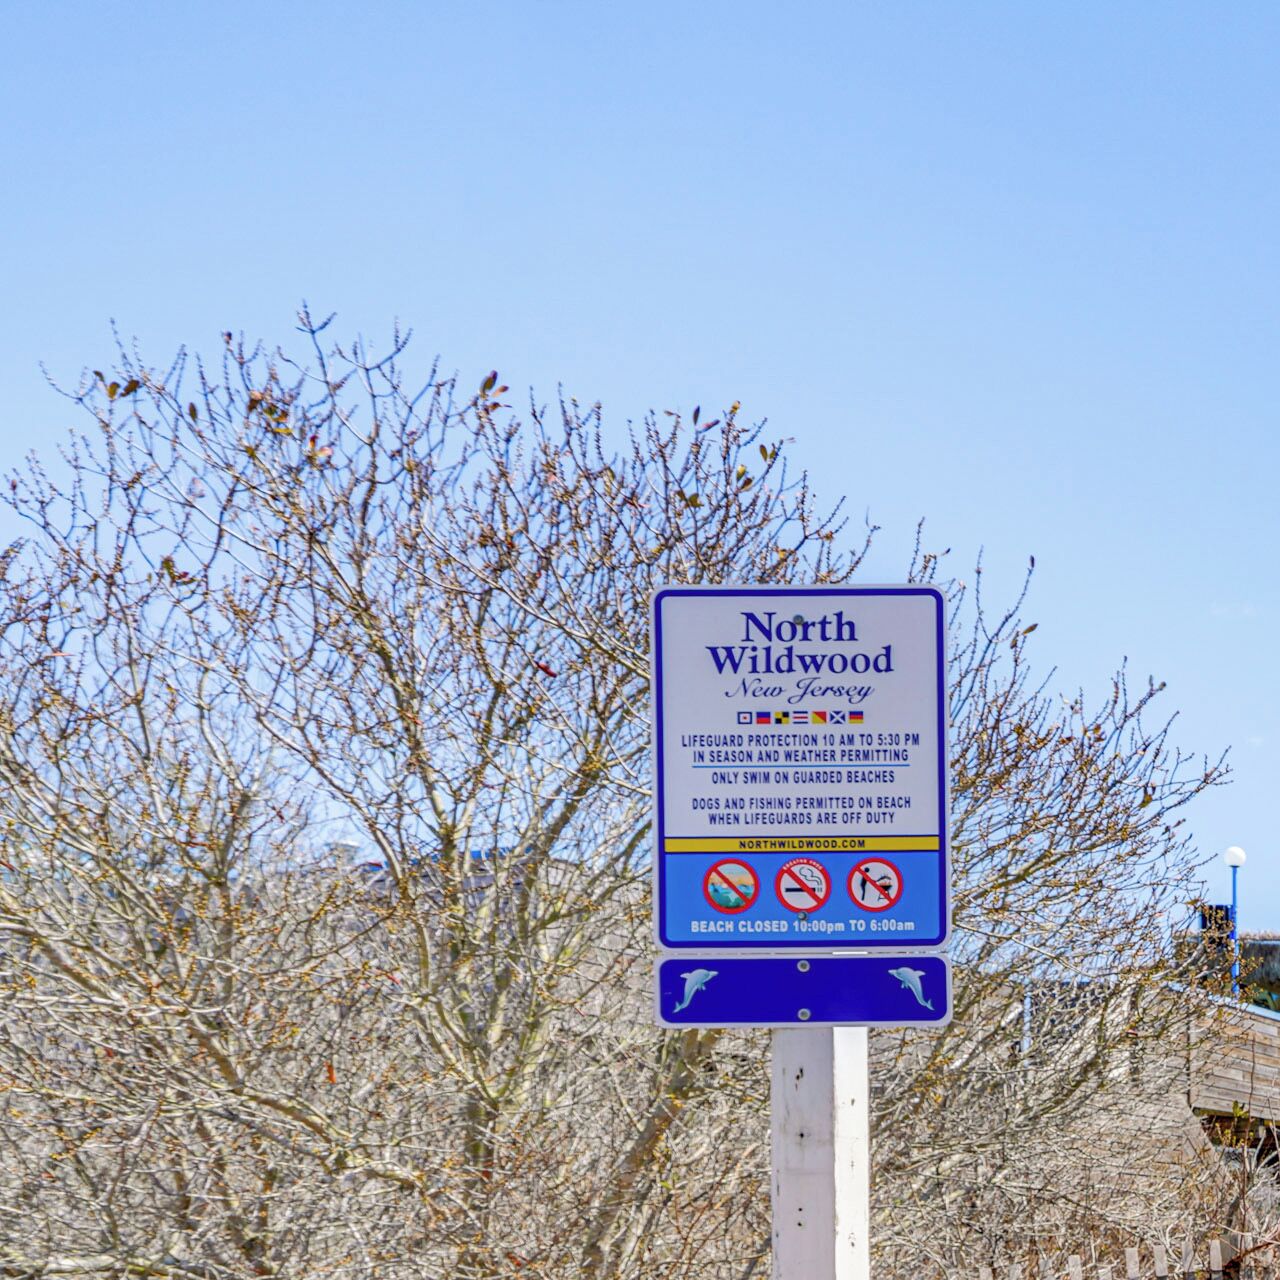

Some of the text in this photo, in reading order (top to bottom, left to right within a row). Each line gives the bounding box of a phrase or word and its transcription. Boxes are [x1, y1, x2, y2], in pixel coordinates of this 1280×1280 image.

[740, 611, 858, 642] North
[705, 645, 895, 674] Wildwood
[724, 677, 875, 704] New Jersey
[681, 733, 920, 748] LIFEGUARD PROTECTION 10 AM TO 5:30 PM
[693, 749, 909, 763] IN SEASON AND WEATHER PERMITTING
[712, 770, 895, 784] ONLY SWIM ON GUARDED BEACHES
[692, 796, 912, 810] DOGS AND FISHING PERMITTED ON BEACH
[708, 812, 895, 825] WHEN LIFEGUARDS ARE OFF DUTY
[739, 839, 866, 850] NORTHWILDWOOD.COM
[690, 919, 915, 935] BEACH CLOSED 10:00pm TO 6:00am
